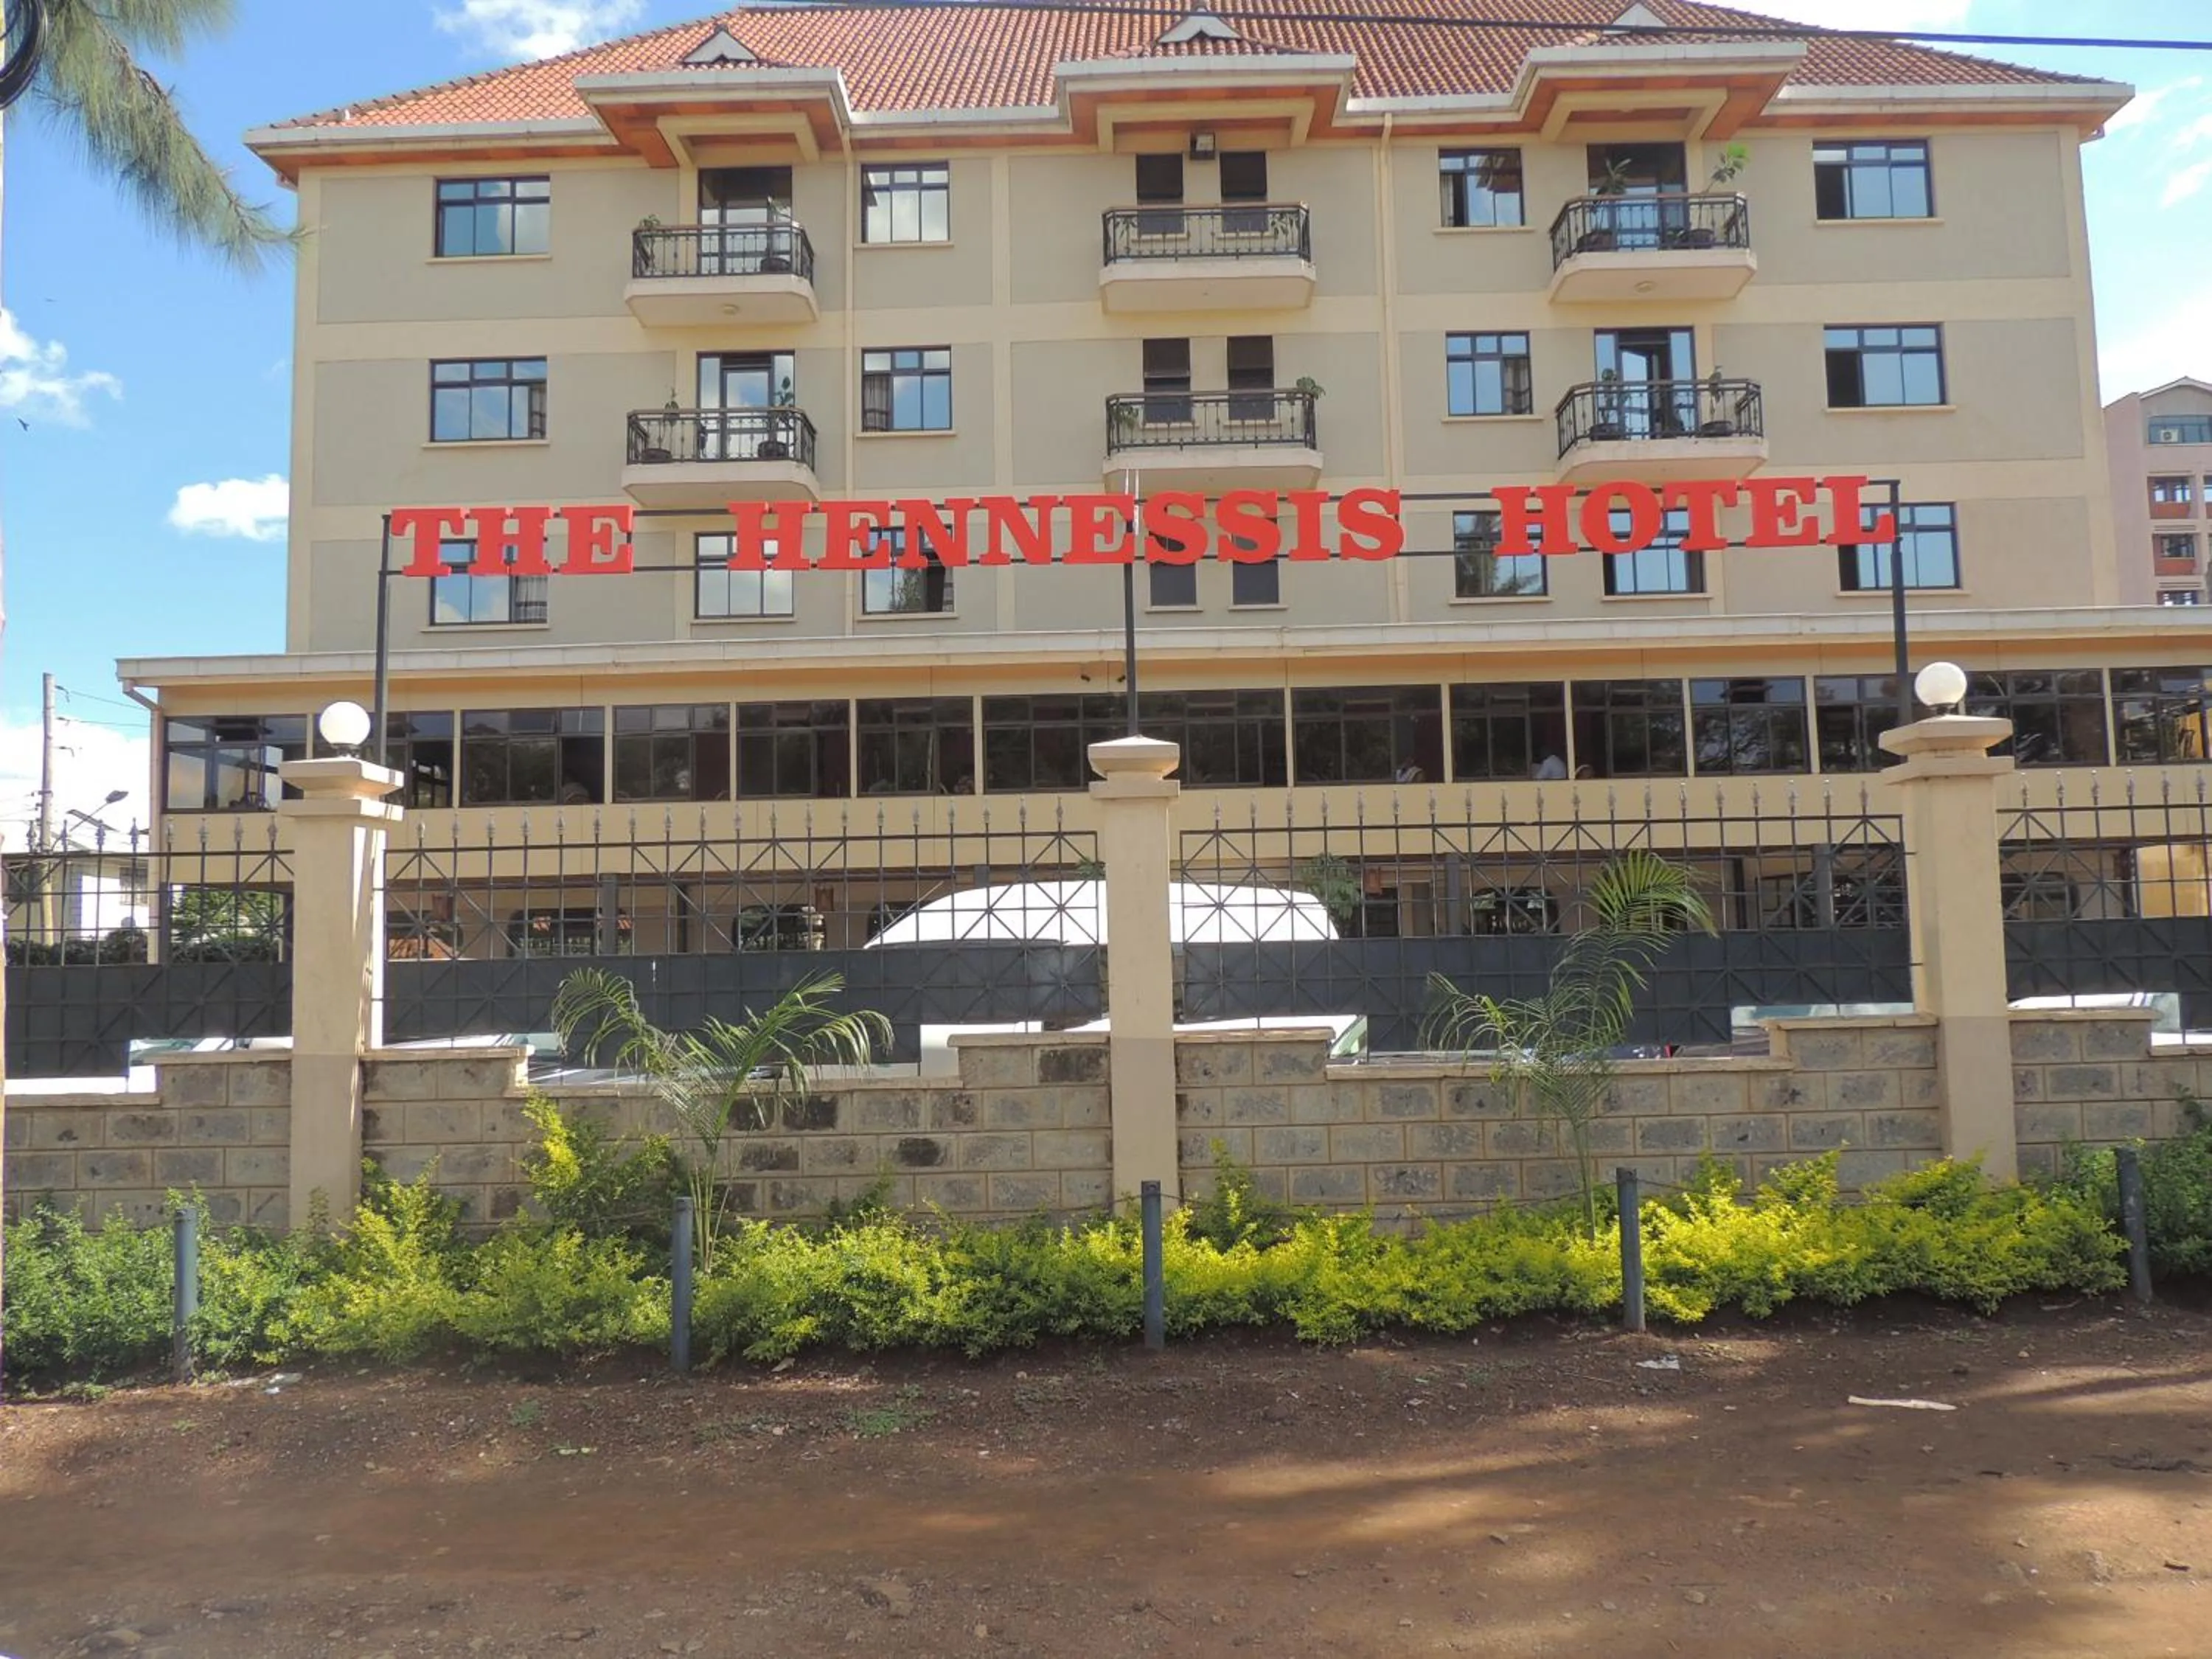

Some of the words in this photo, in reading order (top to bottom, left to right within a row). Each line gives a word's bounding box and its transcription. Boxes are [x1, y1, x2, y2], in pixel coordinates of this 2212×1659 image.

[390, 505, 635, 576] THE
[727, 488, 1404, 570] HENNESSIS
[1491, 476, 1896, 556] HOTEL
